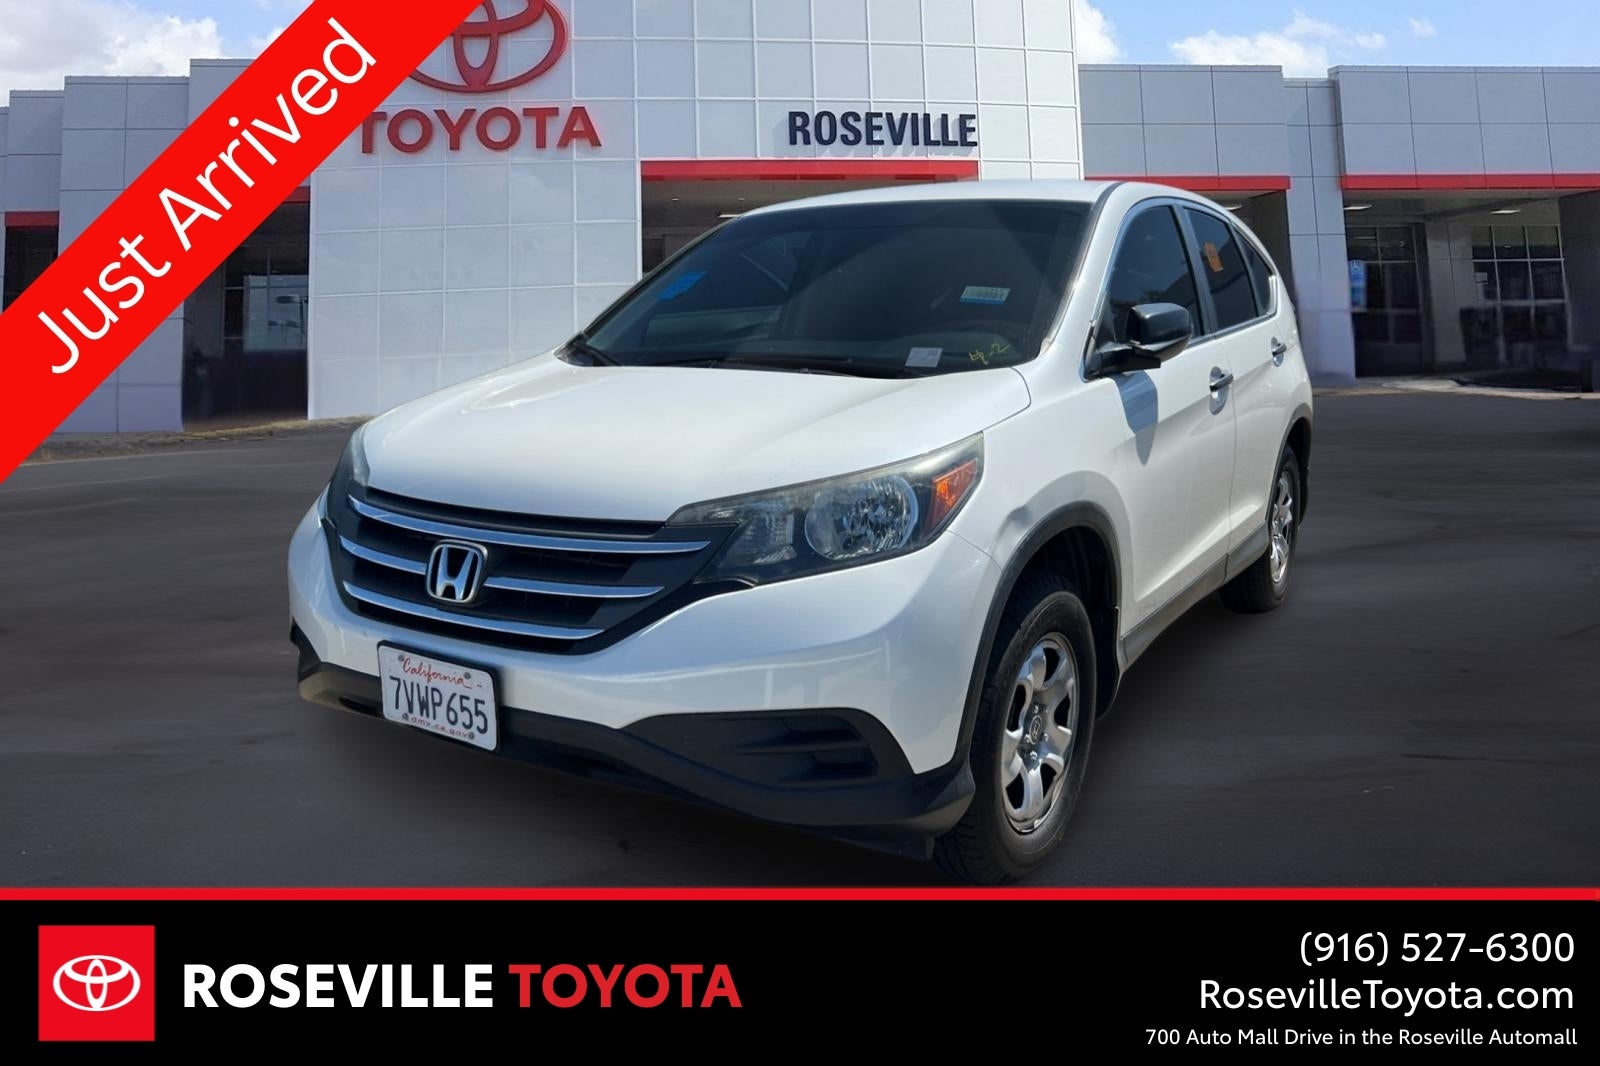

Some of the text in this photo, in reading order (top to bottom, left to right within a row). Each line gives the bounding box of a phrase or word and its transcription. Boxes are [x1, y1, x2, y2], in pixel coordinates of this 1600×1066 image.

[361, 106, 602, 154] TOYOTA
[788, 110, 978, 147] ROSEVILLE
[402, 656, 472, 690] California
[389, 675, 488, 735] 7VWP655
